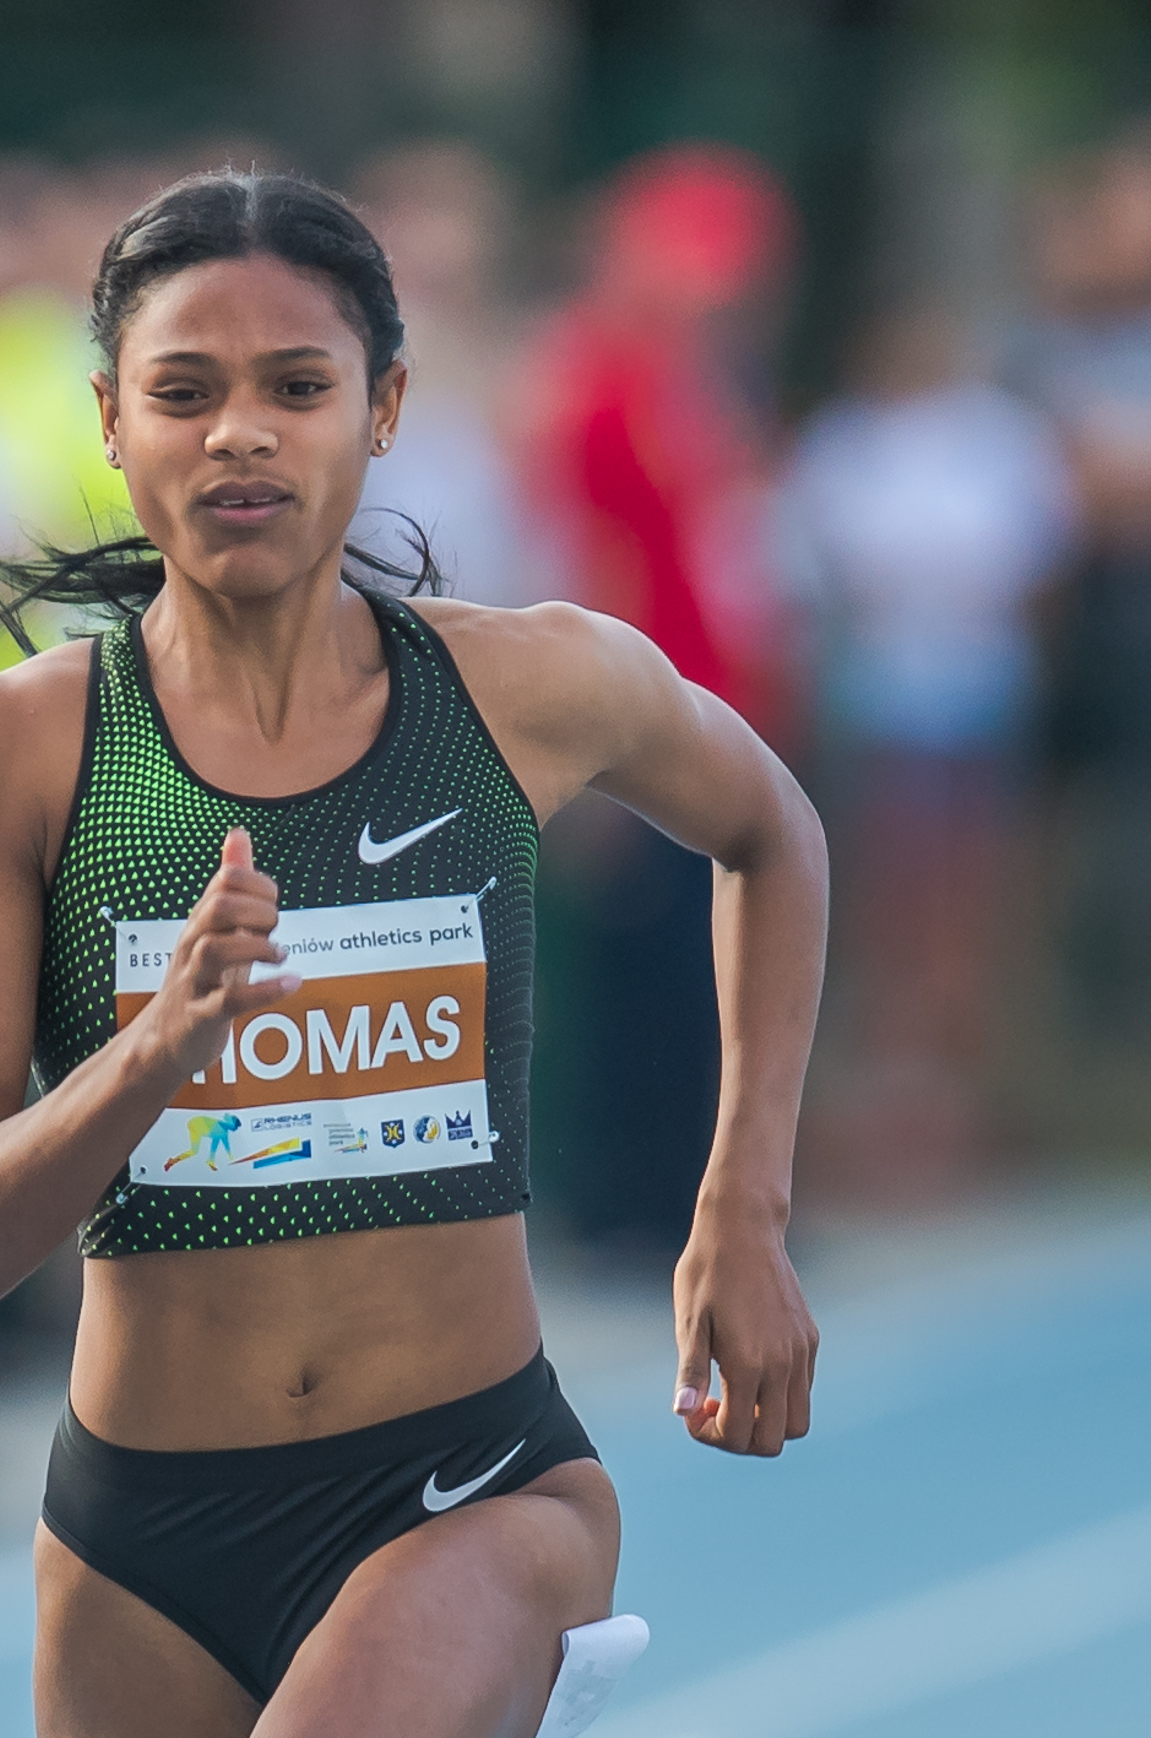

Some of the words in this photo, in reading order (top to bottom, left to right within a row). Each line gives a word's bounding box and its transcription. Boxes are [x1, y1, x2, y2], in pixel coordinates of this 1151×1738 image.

[339, 929, 423, 951] athletics
[429, 922, 474, 946] park
[191, 994, 461, 1084] OMAS
